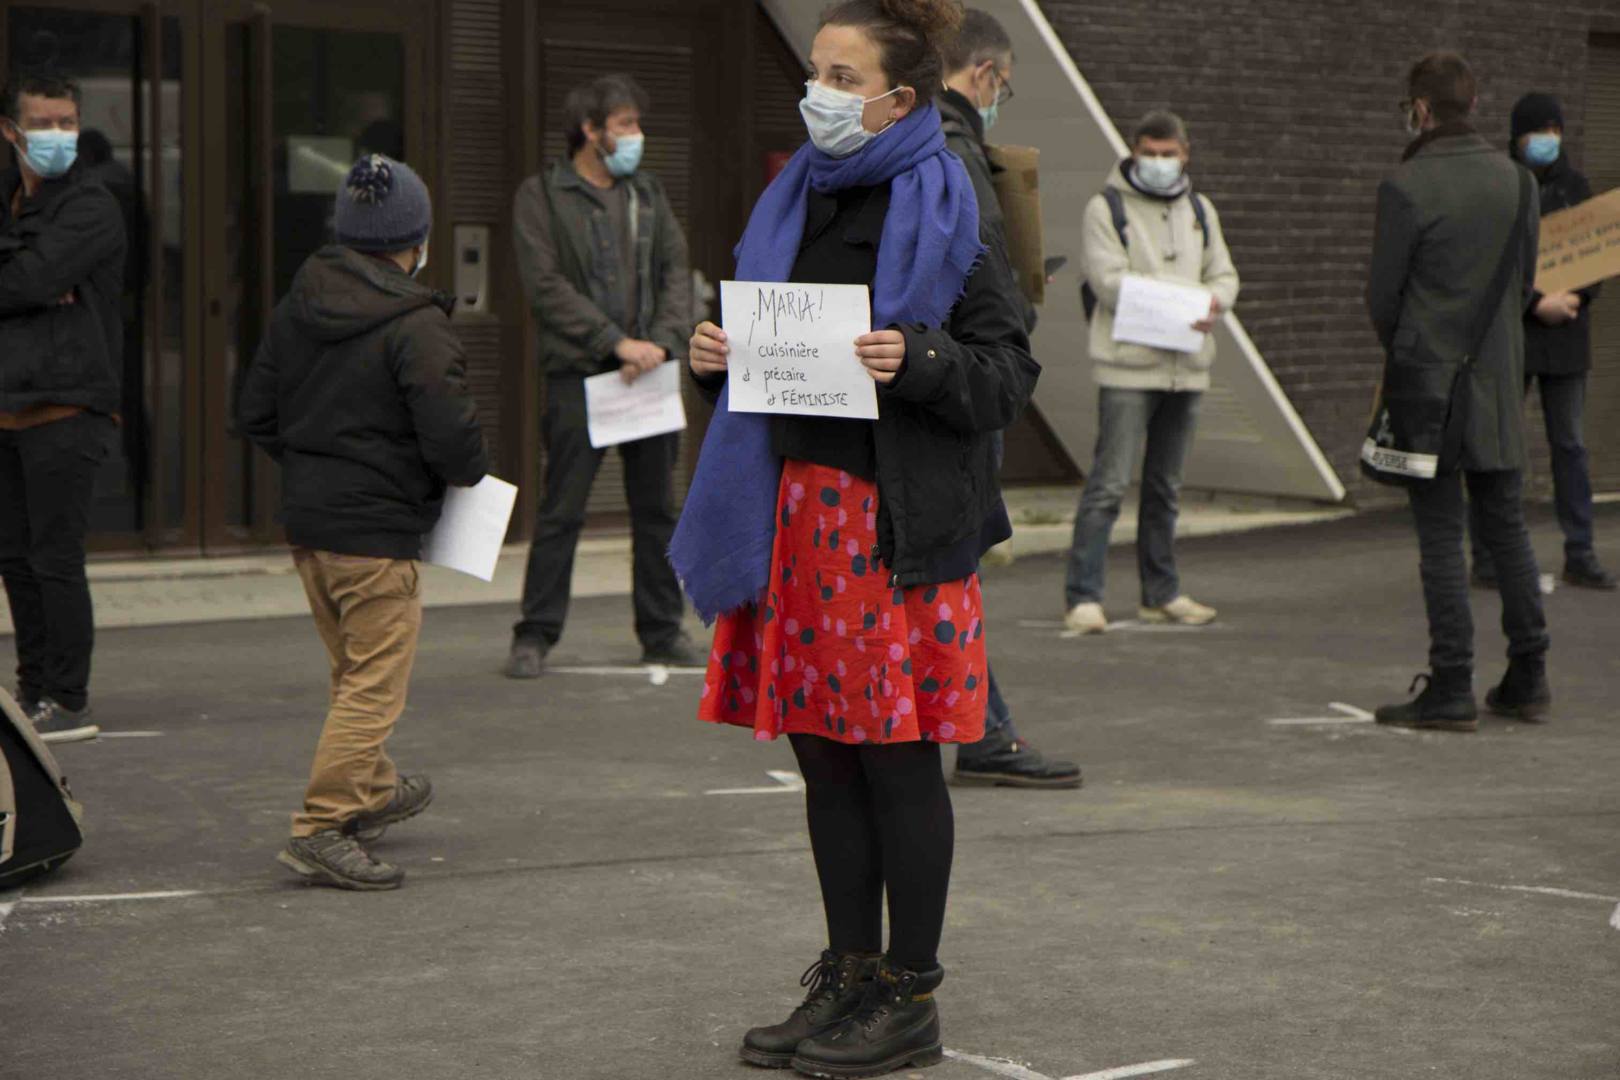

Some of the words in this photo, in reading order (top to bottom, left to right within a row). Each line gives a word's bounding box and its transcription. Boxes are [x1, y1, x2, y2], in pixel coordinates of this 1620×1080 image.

[758, 341, 820, 359] cuisinière
[742, 367, 751, 382] et
[764, 366, 807, 393] précaire
[767, 393, 776, 406] et
[781, 389, 849, 406] FÉMINISTE
